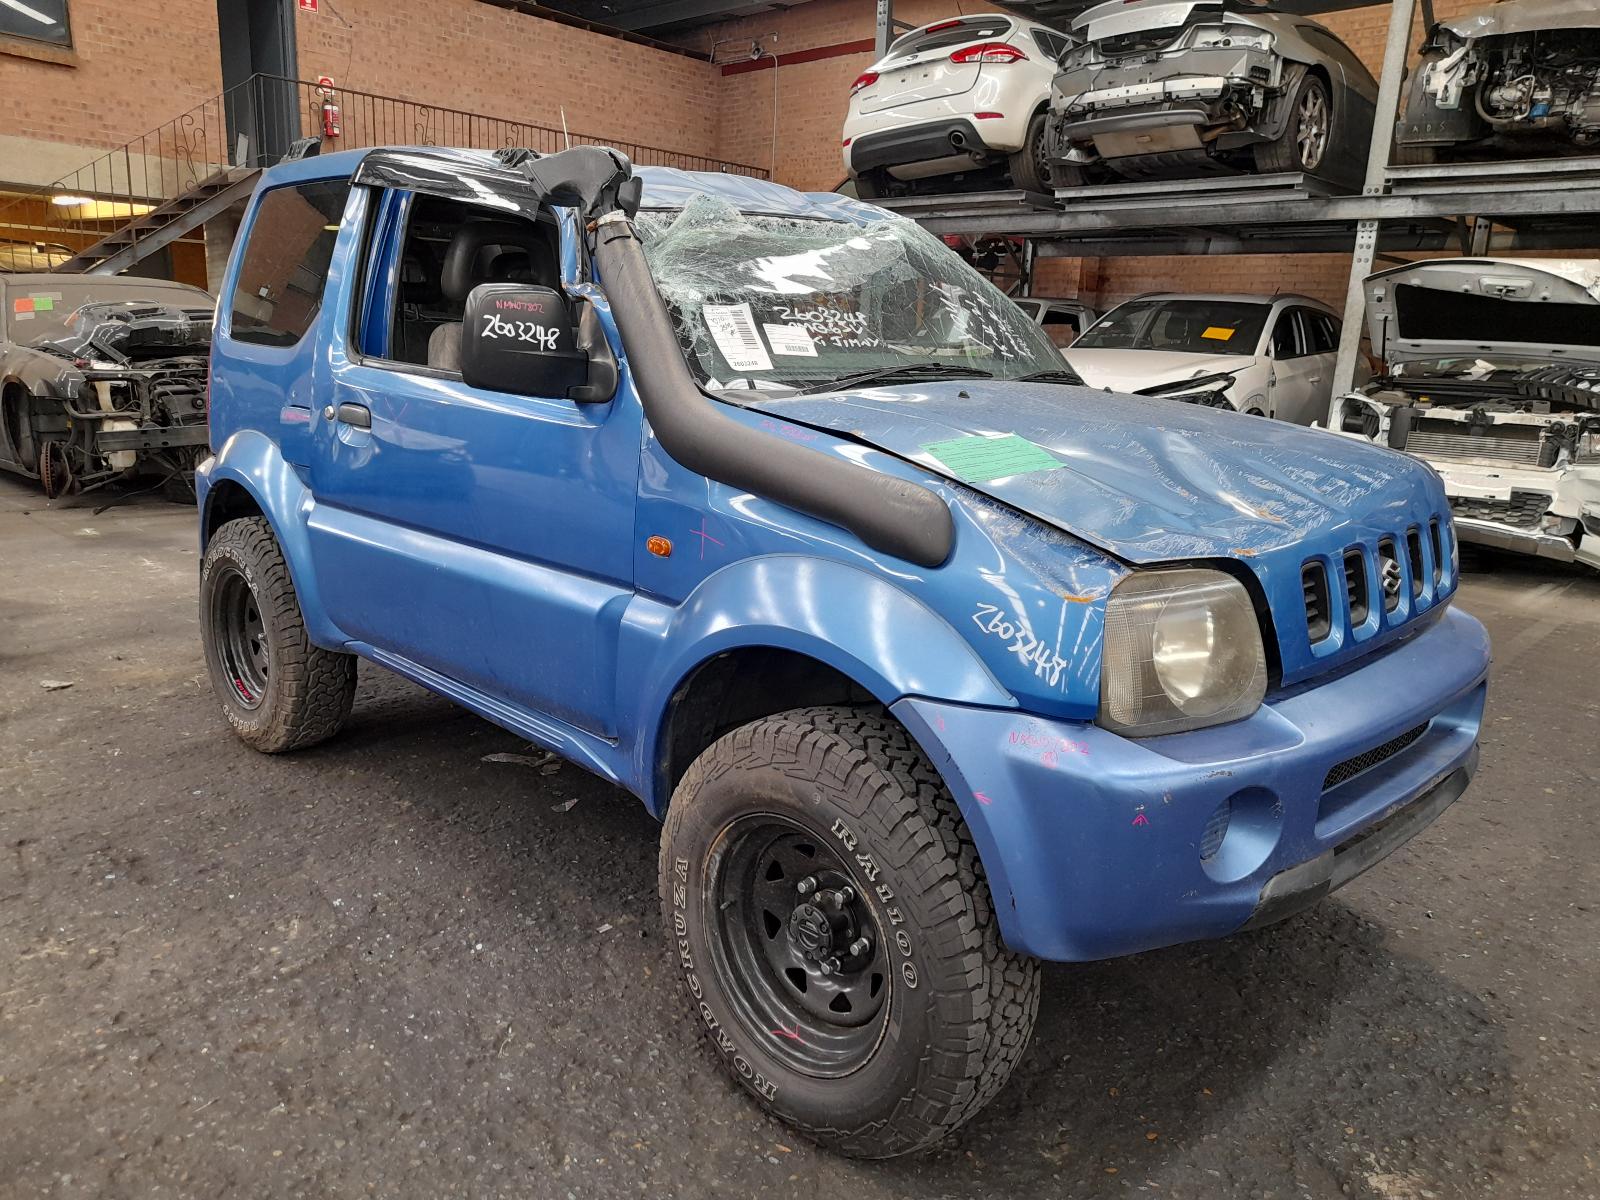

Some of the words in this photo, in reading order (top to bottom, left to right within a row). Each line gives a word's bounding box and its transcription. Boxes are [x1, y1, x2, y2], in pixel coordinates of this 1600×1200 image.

[481, 314, 560, 351] 2603248
[830, 336, 879, 348] JIMNY
[972, 603, 1067, 687] 2603248
[673, 857, 779, 1101] ROADCRUZA
